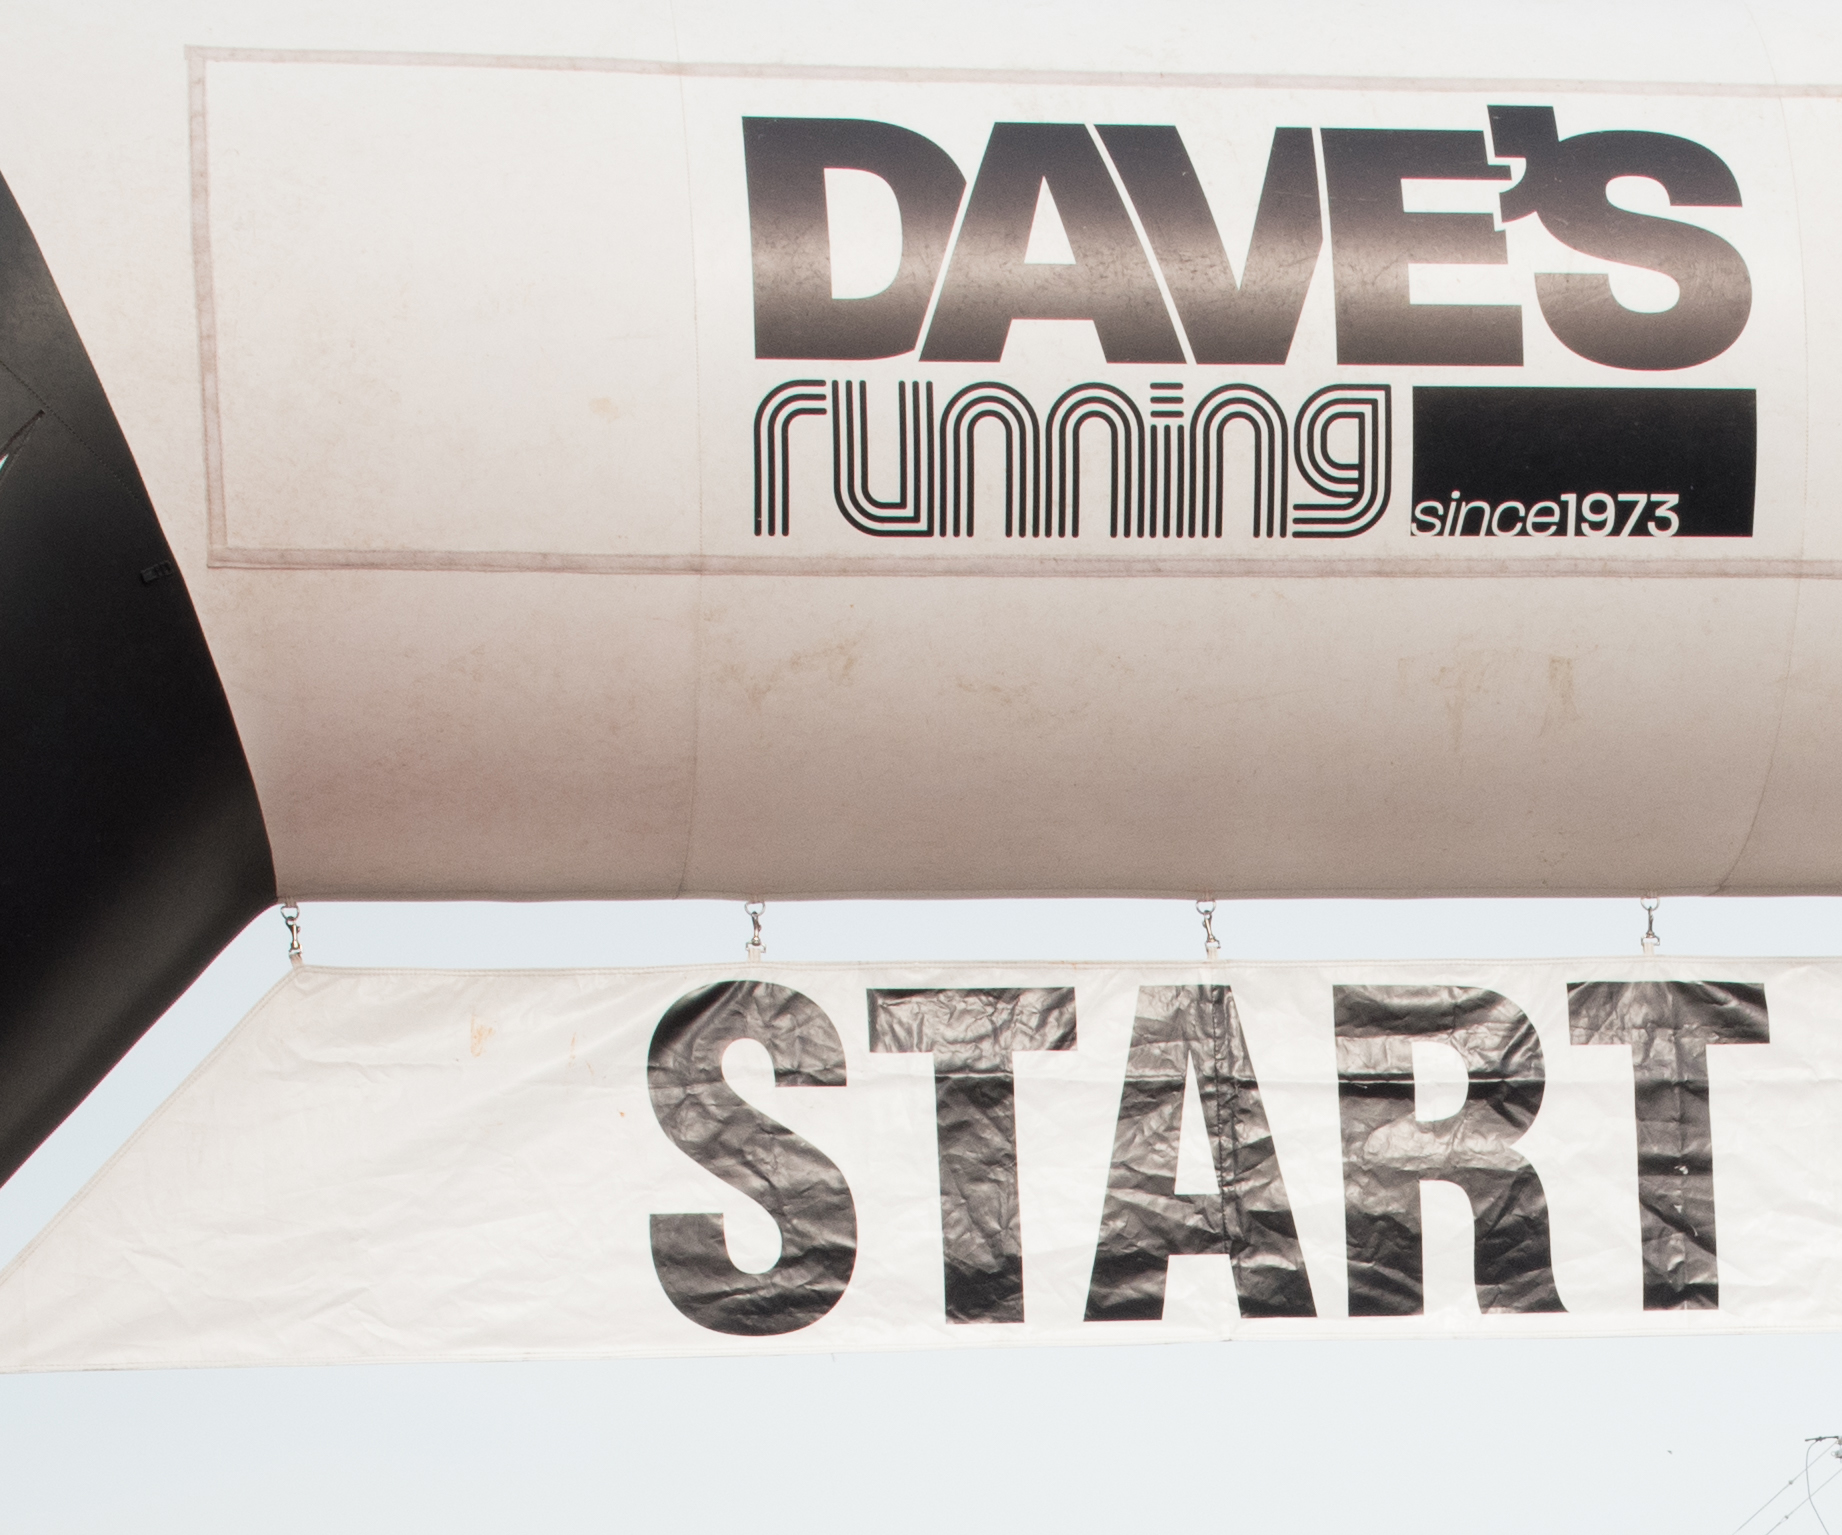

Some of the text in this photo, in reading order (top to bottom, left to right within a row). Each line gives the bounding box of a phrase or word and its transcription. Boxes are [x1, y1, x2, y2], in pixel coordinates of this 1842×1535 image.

[741, 105, 1753, 371] DAVE'S
[754, 379, 1393, 539] running
[647, 979, 1771, 1337] START
